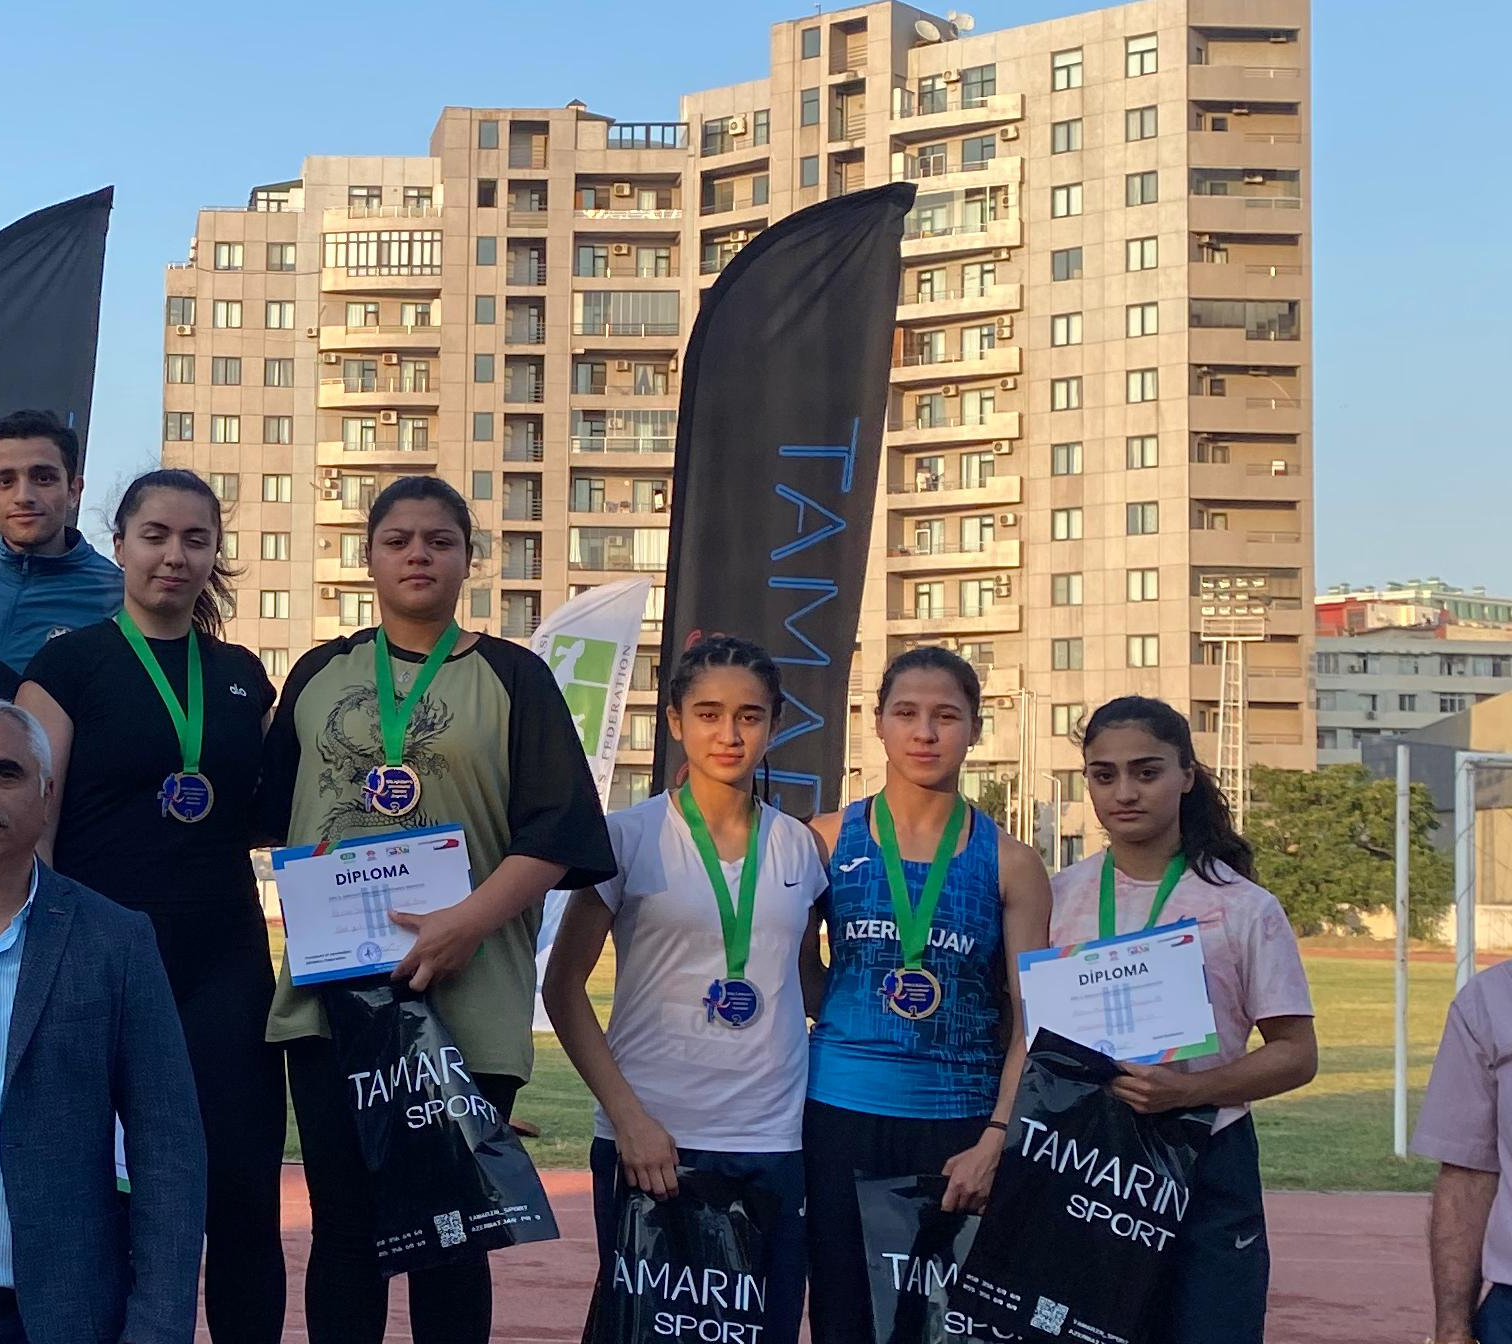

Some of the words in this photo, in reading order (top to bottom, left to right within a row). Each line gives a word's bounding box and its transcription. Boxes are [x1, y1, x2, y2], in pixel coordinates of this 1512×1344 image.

[602, 645, 631, 760] FEDERATION
[335, 863, 410, 886] DİPLOMA
[845, 919, 975, 955] AZERIJAN
[1078, 962, 1149, 986] DİPLOMA
[405, 1094, 498, 1129] SPORT
[1020, 1116, 1190, 1222] TAMARIN
[1066, 1194, 1176, 1252] SPORT
[613, 1250, 766, 1313] AMARIN
